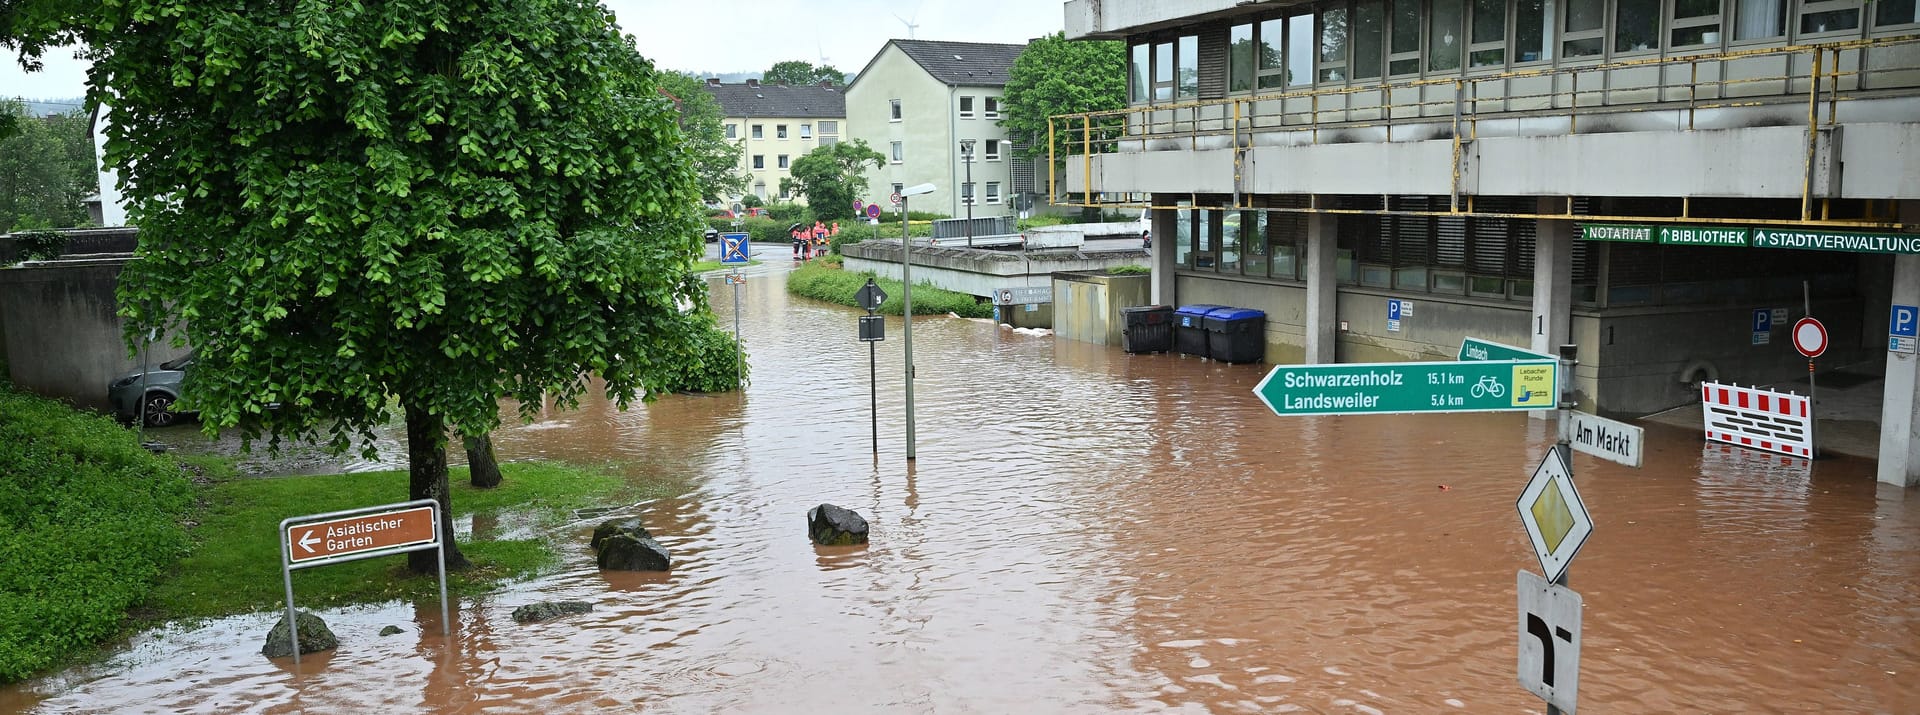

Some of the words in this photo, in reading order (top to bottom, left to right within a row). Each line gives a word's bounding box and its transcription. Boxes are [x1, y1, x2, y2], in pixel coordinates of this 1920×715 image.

[1589, 227, 1651, 241] NOTARIAT
[1671, 230, 1745, 244] BIBLIOTHEK
[1769, 232, 1920, 252] STADTVERWALTUNG
[1390, 302, 1398, 318] P
[1536, 314, 1544, 335] 1
[1757, 312, 1767, 330] P
[1896, 309, 1912, 332] P
[1607, 325, 1614, 346] 1
[1466, 343, 1489, 361] Limbach
[1284, 369, 1403, 388] Schwarzenholz
[1448, 372, 1464, 385] km
[1284, 392, 1380, 410] Landsweiler
[1448, 394, 1464, 406] km
[1576, 419, 1593, 446] Am
[1596, 424, 1630, 457] Markt
[326, 518, 404, 539] Asiatischer
[326, 536, 373, 551] Garten
